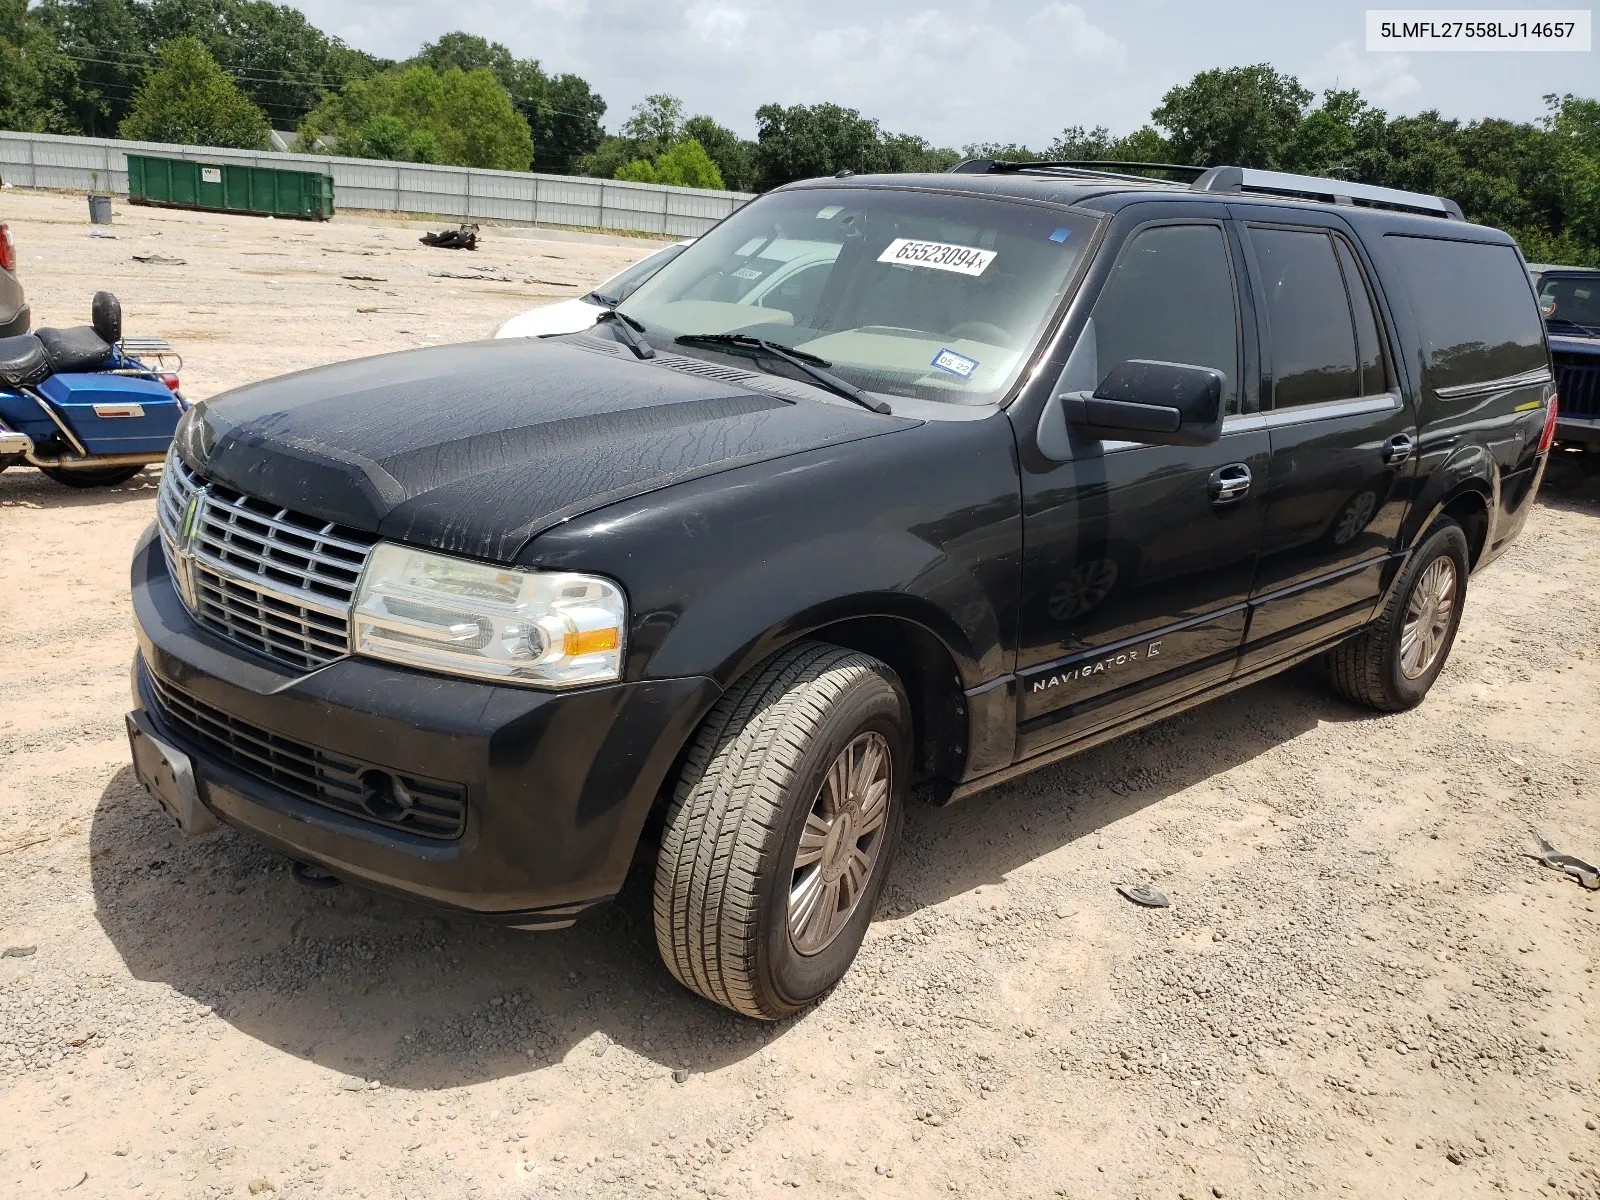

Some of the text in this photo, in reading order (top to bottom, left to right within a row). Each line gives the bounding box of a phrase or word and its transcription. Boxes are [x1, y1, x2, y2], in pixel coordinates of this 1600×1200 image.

[940, 356, 969, 373] 05 22
[1033, 651, 1138, 692] NAVIGATOR
